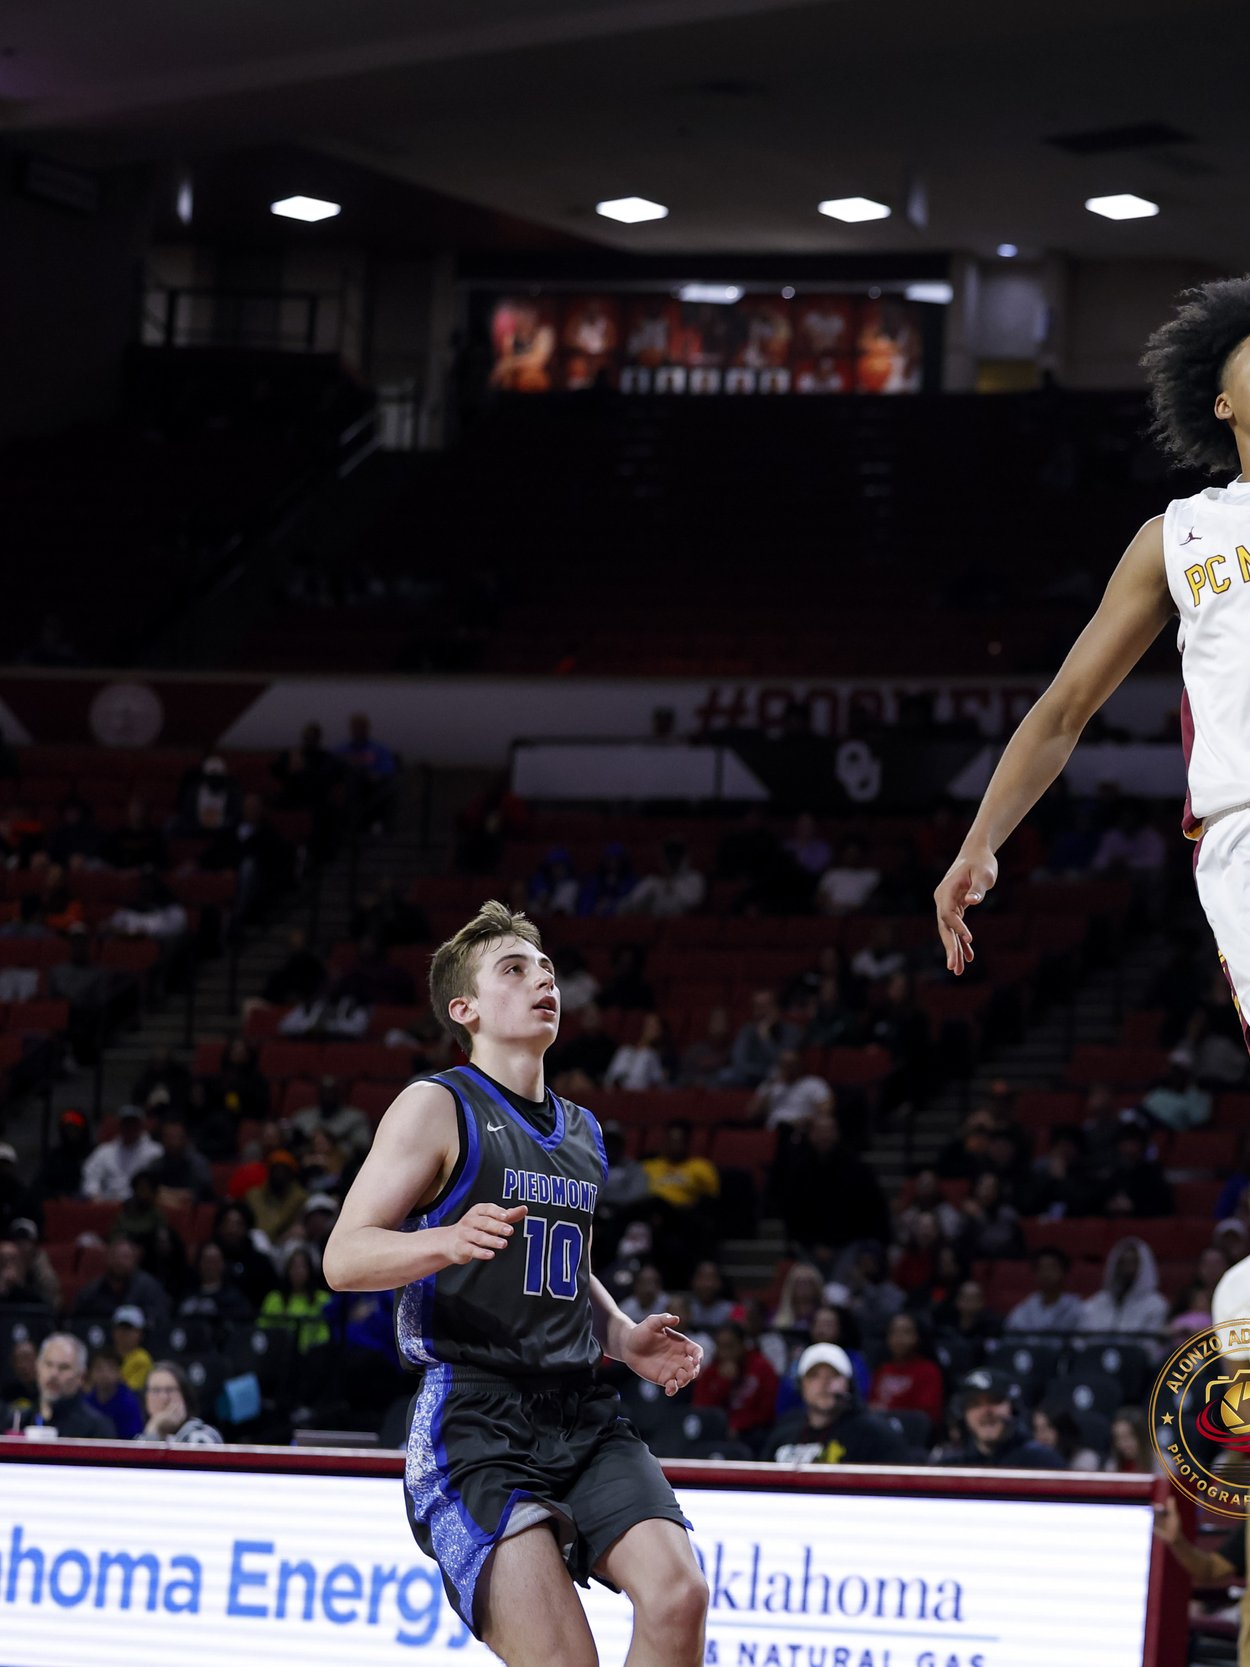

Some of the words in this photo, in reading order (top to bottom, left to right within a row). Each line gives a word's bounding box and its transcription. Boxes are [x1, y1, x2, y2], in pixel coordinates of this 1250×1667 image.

[1184, 554, 1231, 608] PC
[502, 1167, 598, 1215] PIEDMONT
[523, 1215, 584, 1302] 10
[0, 1524, 203, 1614] homa
[225, 1539, 472, 1650] Energ
[694, 1541, 965, 1622] klahoma
